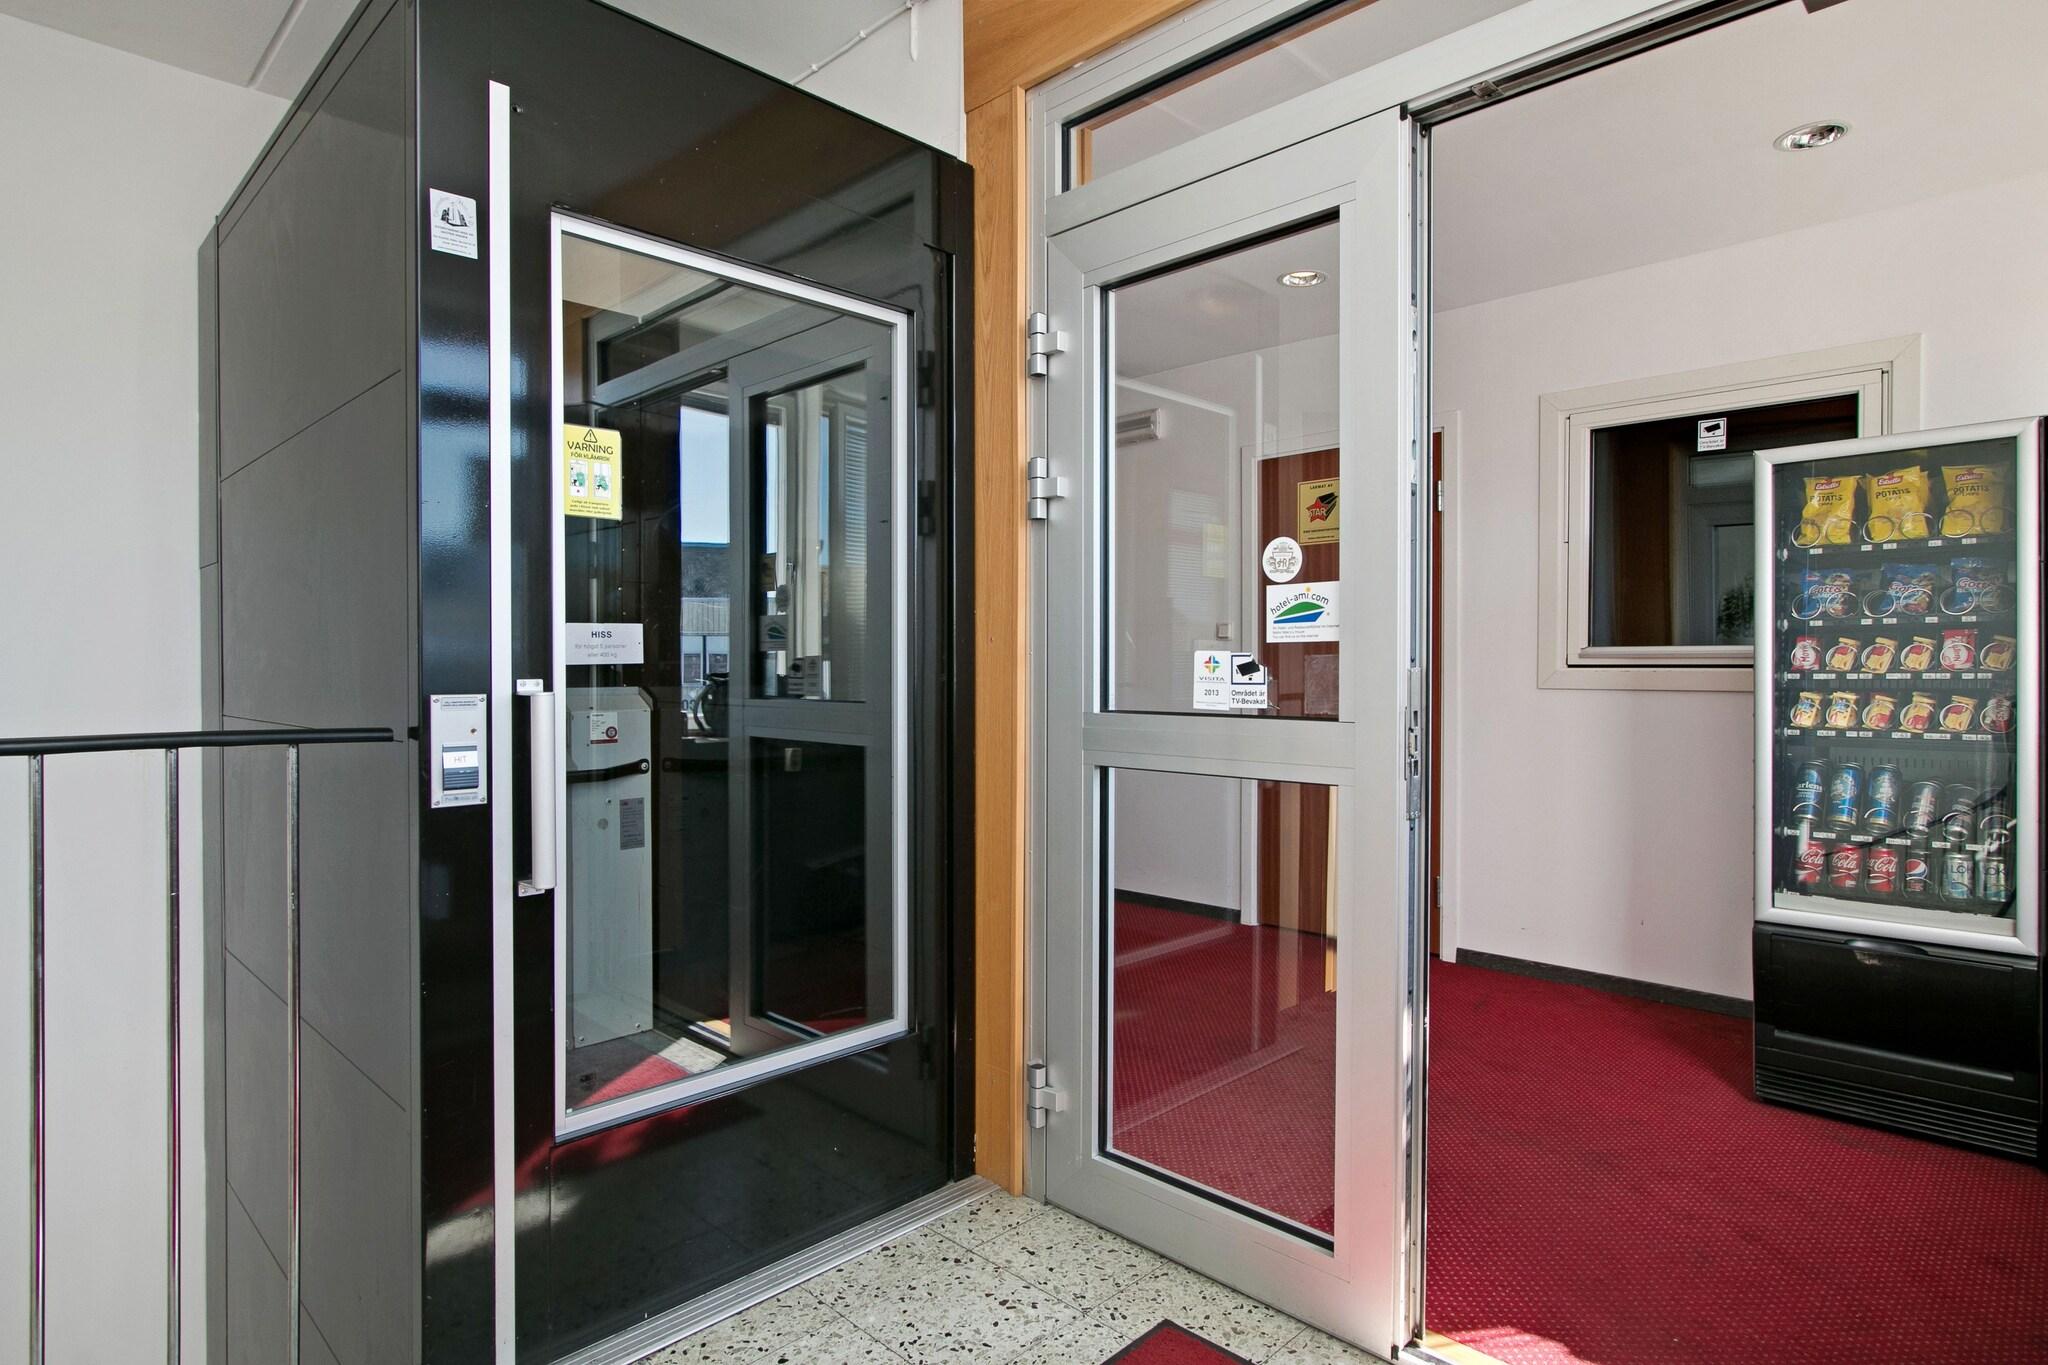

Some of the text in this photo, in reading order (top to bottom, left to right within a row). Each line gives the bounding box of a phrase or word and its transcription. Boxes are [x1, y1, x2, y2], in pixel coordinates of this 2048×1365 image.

[567, 441, 614, 455] VARNING
[1875, 488, 1911, 499] POTATIS
[1309, 507, 1327, 517] STAR
[591, 630, 613, 639] HISS
[1231, 689, 1257, 697] Området
[1832, 852, 1857, 868] Cola
